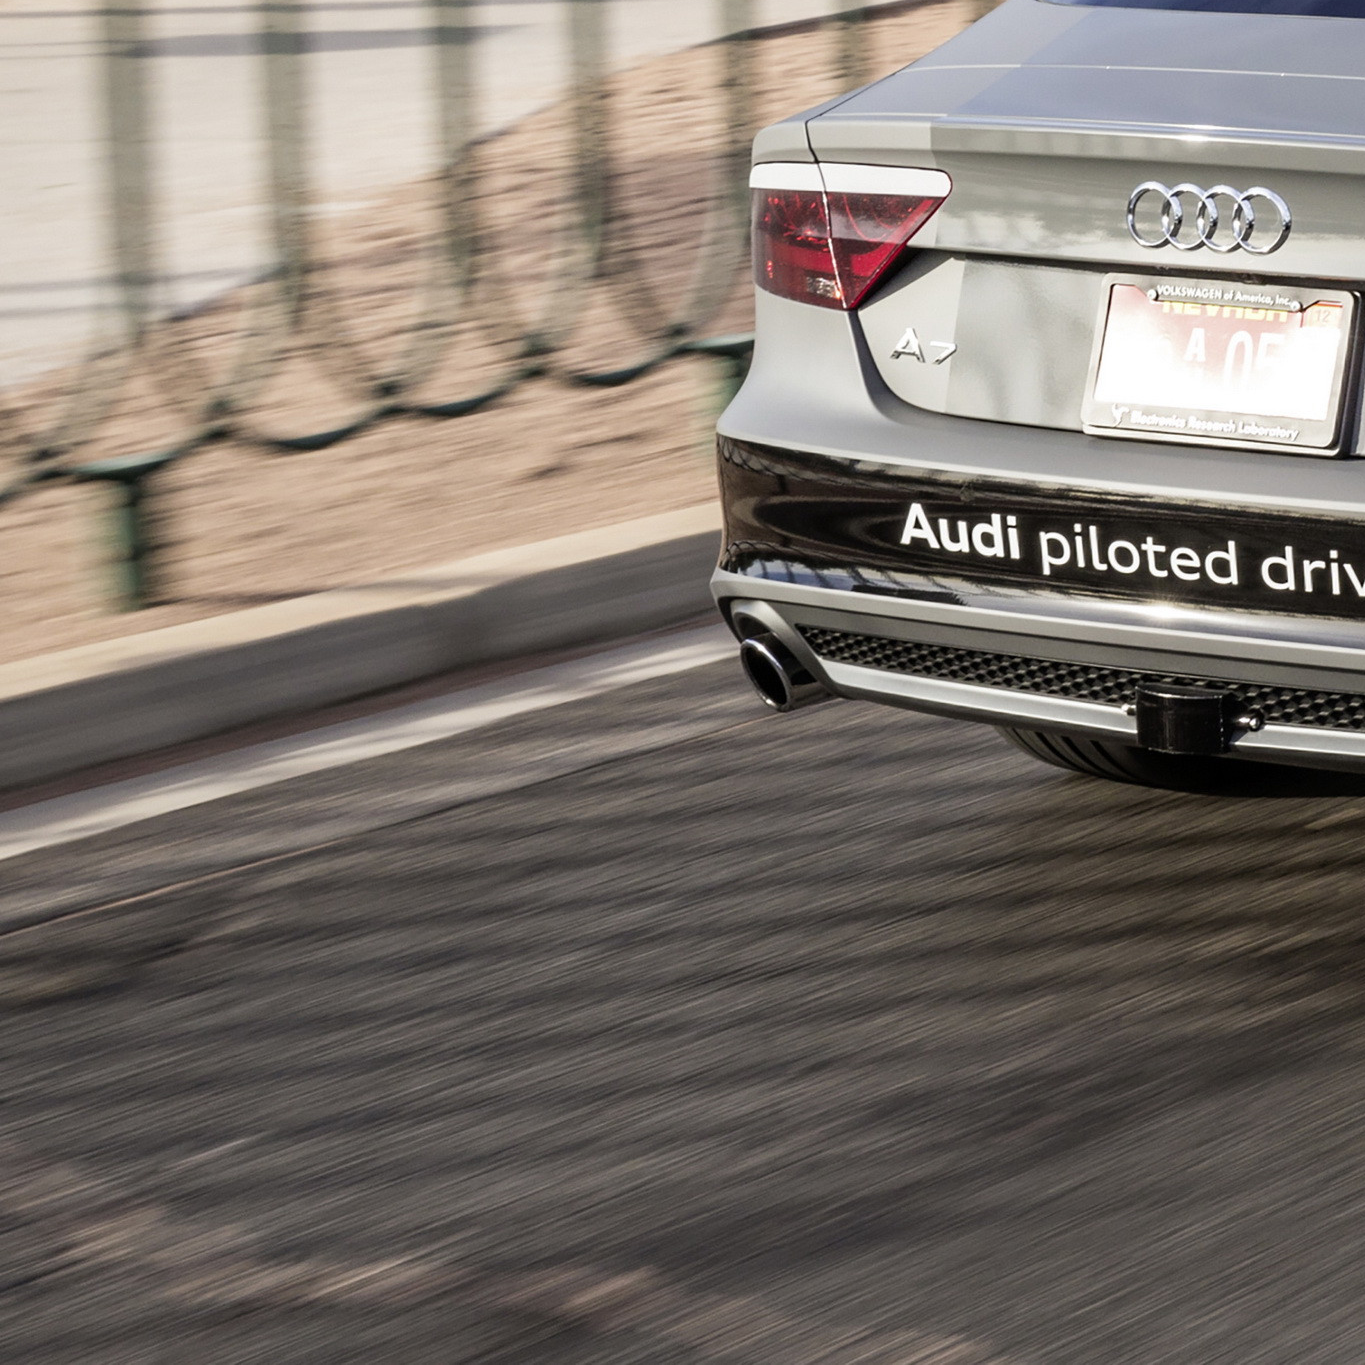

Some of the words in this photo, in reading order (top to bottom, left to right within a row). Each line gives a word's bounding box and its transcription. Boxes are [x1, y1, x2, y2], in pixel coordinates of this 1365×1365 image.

[1157, 285, 1222, 299] VOLKSWAGEN
[1223, 290, 1233, 301] of
[890, 327, 957, 365] A7
[1130, 410, 1186, 429] Electronics
[1187, 415, 1236, 433] Research
[1238, 420, 1299, 442] Laboratory
[900, 502, 1019, 560] Audi
[1038, 523, 1239, 585] piloted
